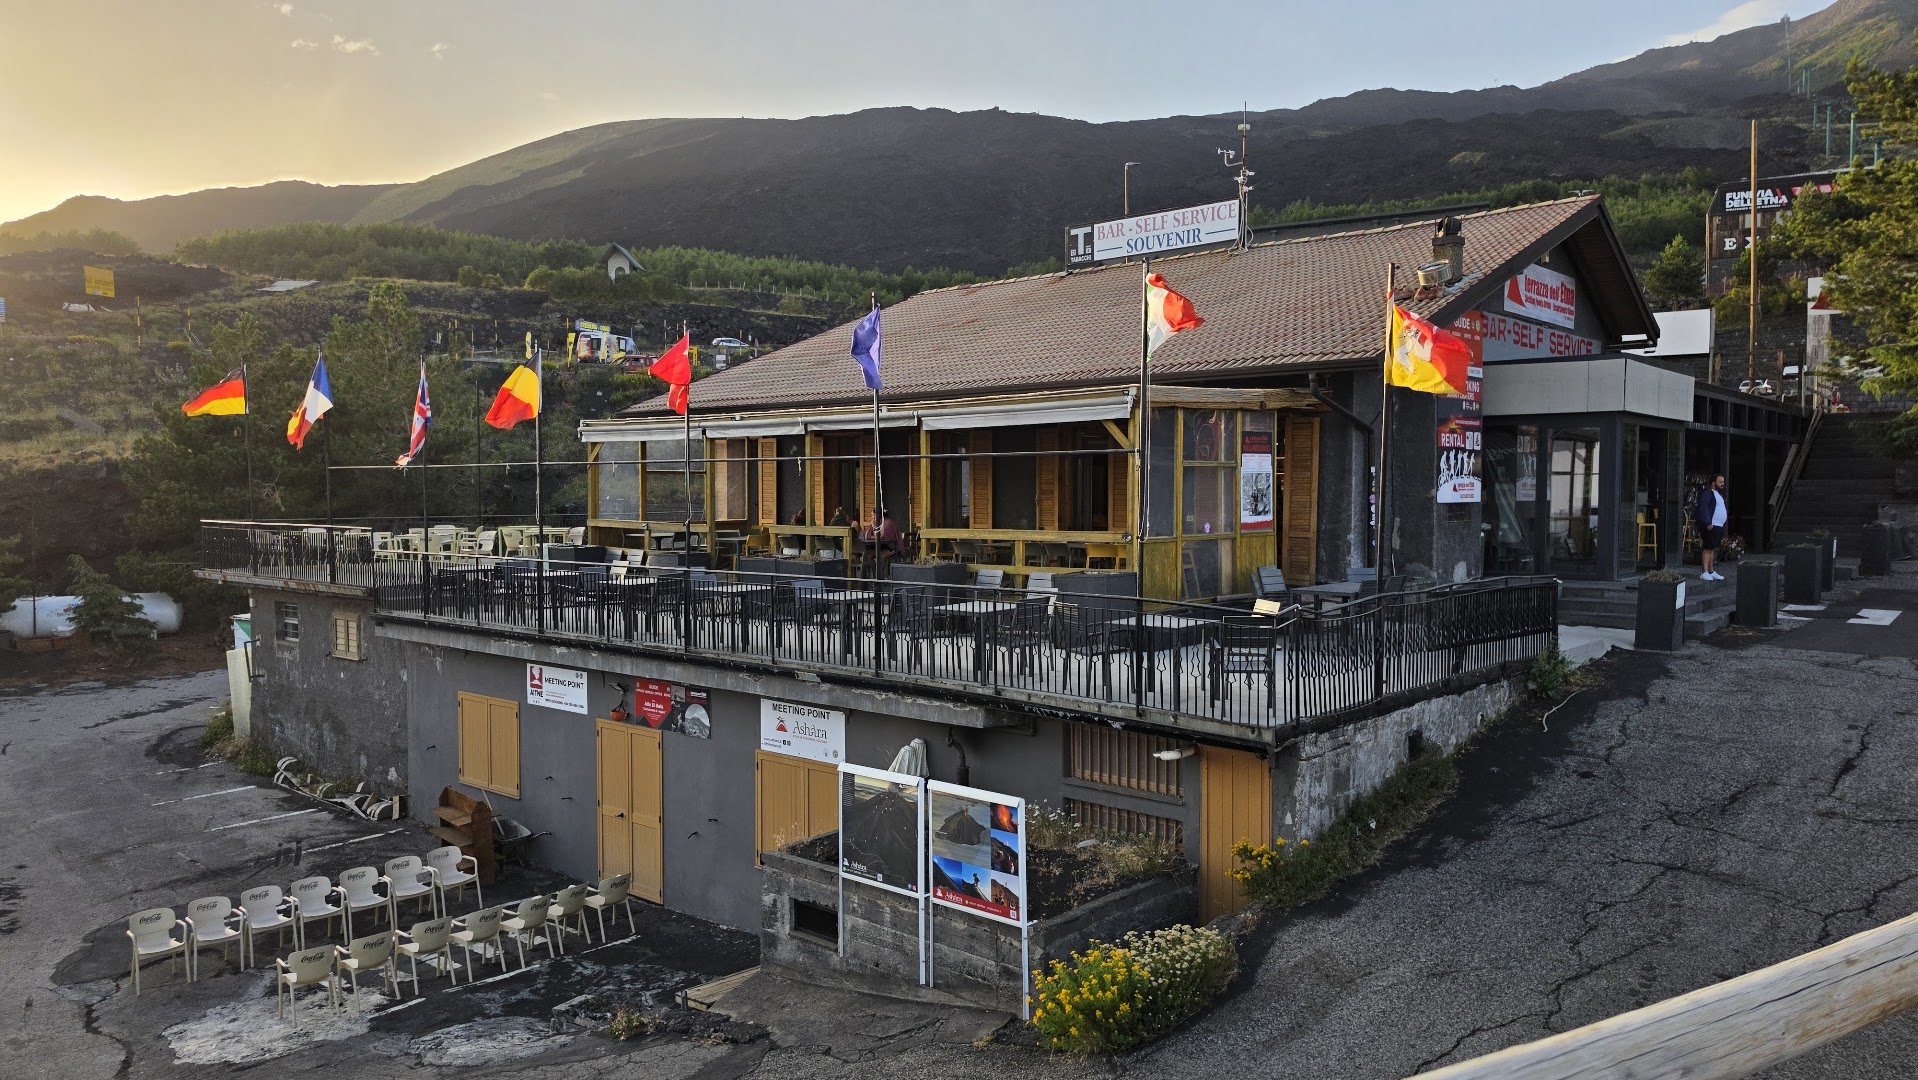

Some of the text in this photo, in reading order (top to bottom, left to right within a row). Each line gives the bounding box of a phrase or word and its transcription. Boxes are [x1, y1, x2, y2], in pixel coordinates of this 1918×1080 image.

[1097, 222, 1125, 240] BAR
[1135, 214, 1168, 234] SELF
[1172, 202, 1237, 228] SERVICE
[1126, 227, 1202, 253] SOUVENIR
[1549, 331, 1594, 356] SERVICE
[1441, 432, 1465, 448] RENTAL
[544, 676, 584, 689] MEETING POINT
[772, 702, 831, 720] MEETING POINT
[391, 859, 410, 870] Coca-Cola
[347, 870, 367, 881] Coca-Cola
[299, 881, 319, 891] Coca-Cola
[249, 889, 270, 901] Coca-Cola
[196, 901, 218, 912] Coca-Cola
[139, 912, 162, 924] Coca-Cola
[424, 922, 446, 934] Coca-Cola
[363, 937, 386, 950] Coca-Cola
[301, 951, 326, 963] Coca-Cola
